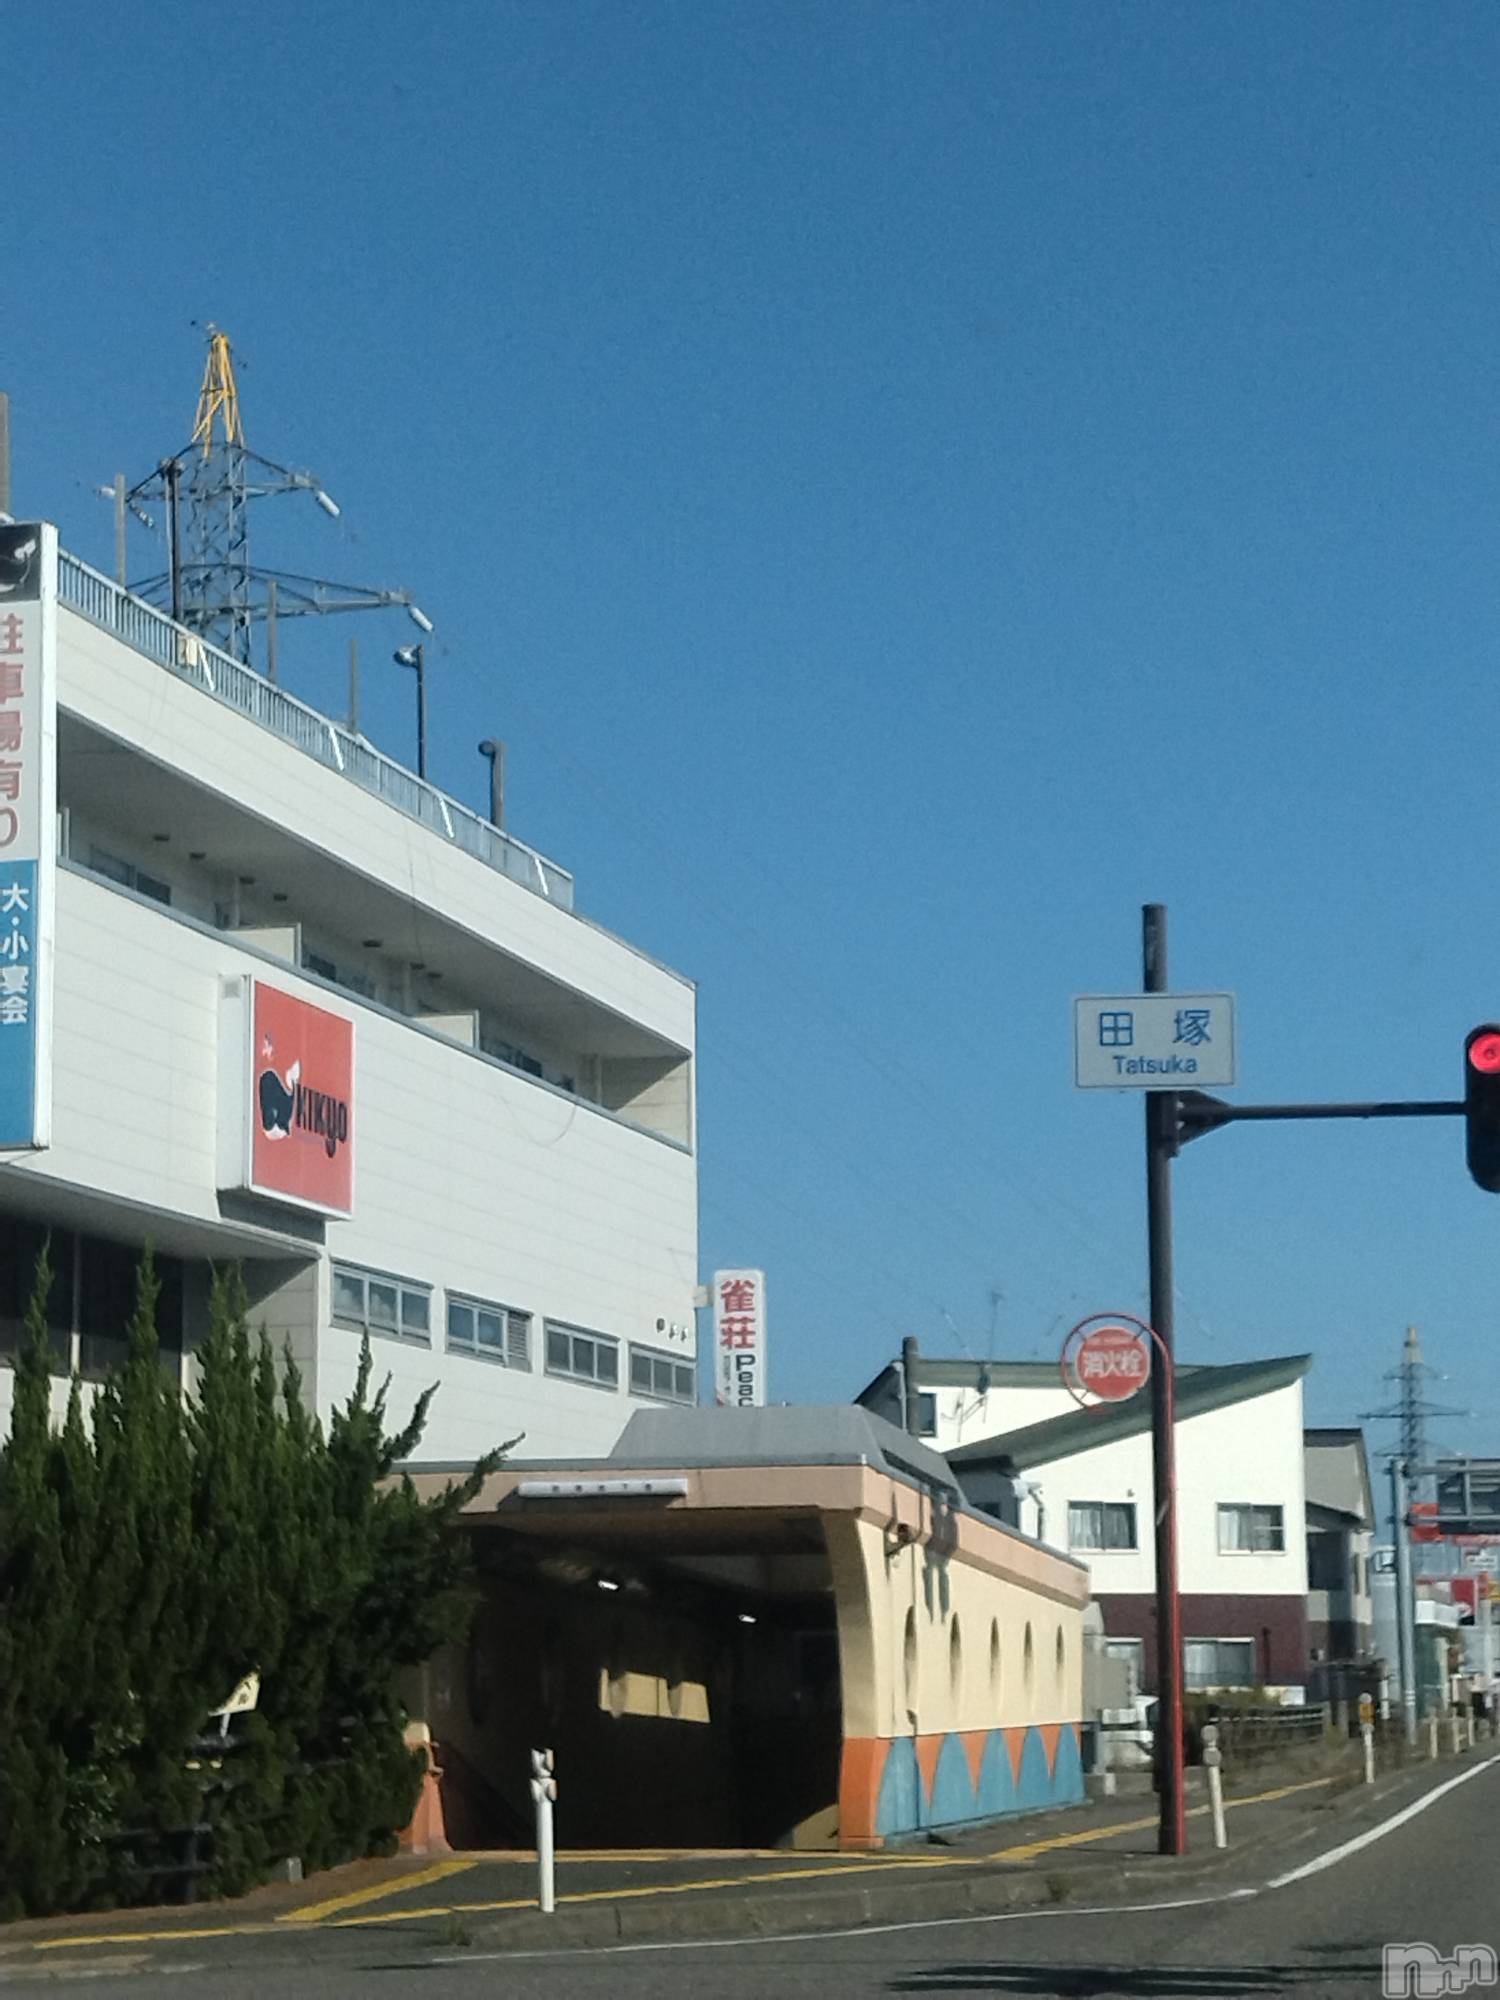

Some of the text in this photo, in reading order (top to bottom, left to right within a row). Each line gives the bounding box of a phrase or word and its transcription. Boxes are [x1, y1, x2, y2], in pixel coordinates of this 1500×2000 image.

[1099, 1009, 1213, 1047] 田塚
[1113, 1054, 1198, 1075] Tatsuka
[720, 1279, 756, 1350] 雀荘
